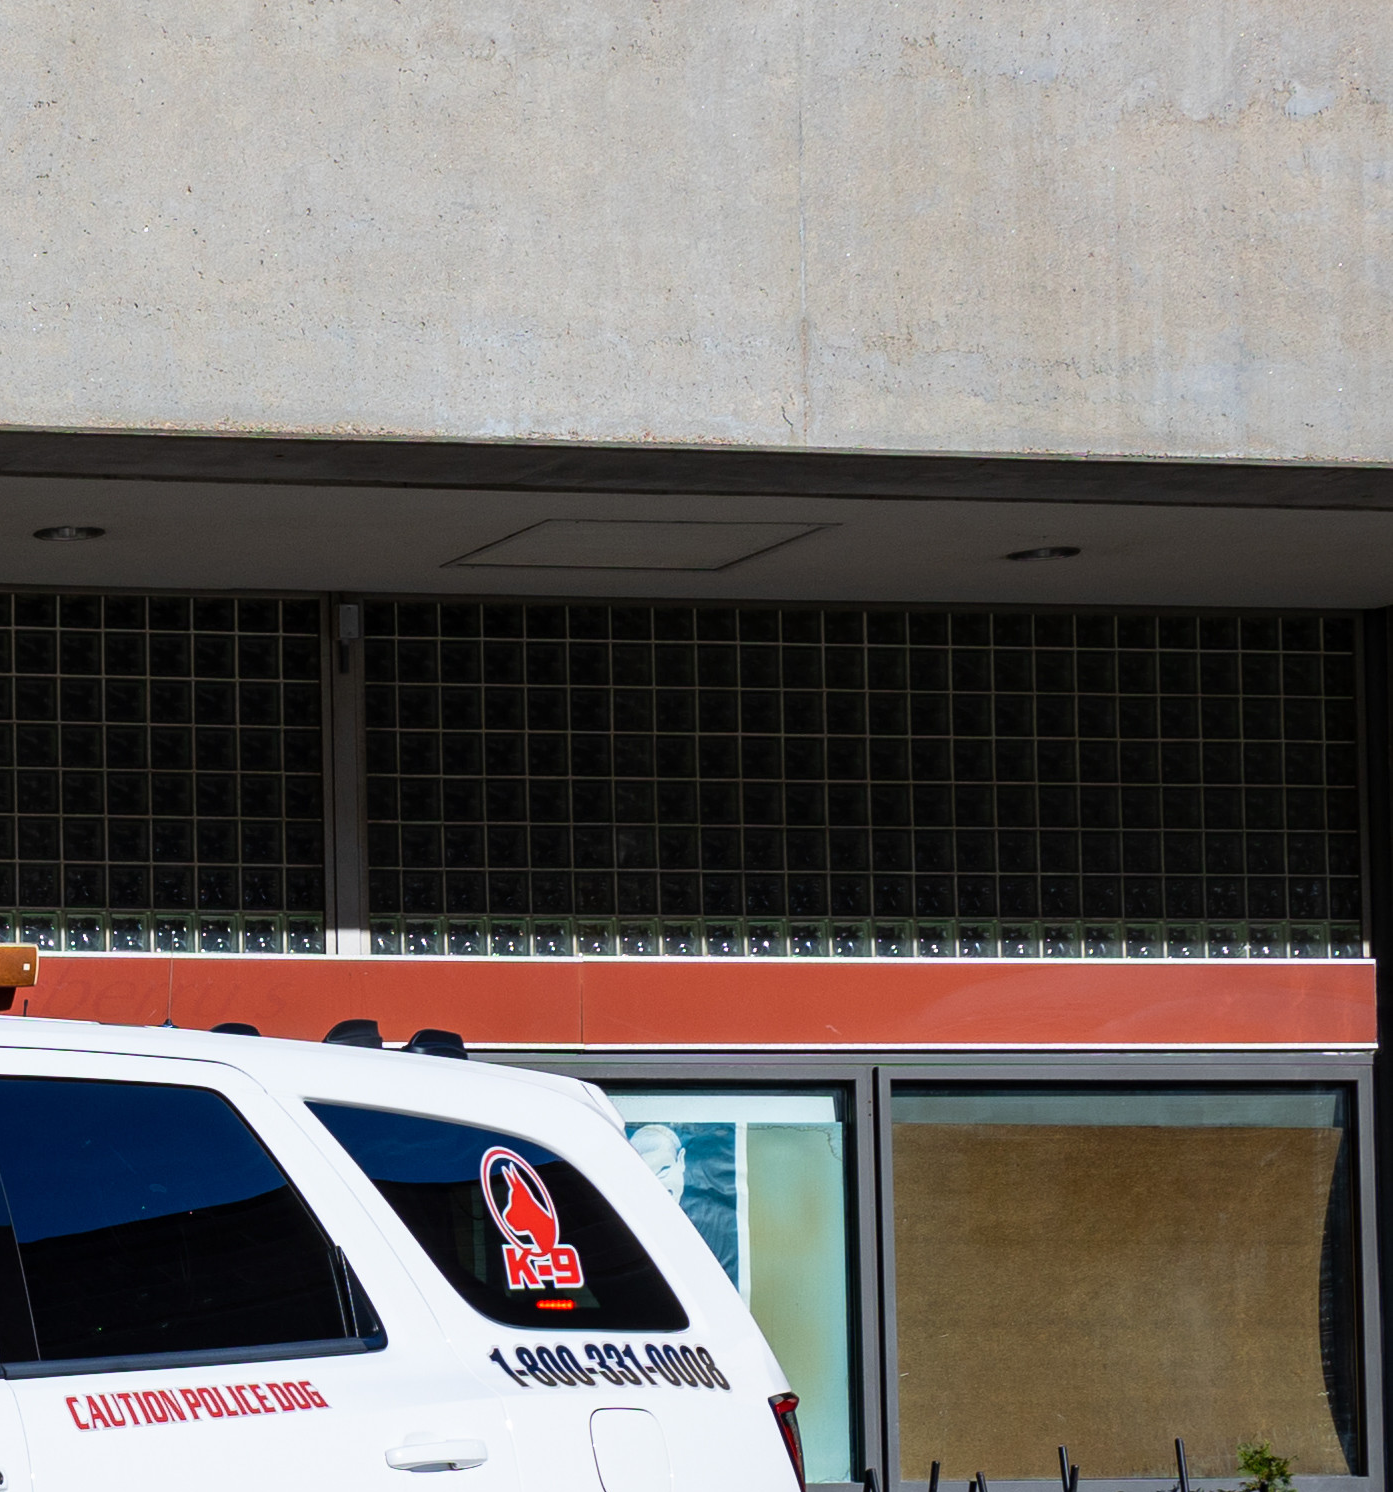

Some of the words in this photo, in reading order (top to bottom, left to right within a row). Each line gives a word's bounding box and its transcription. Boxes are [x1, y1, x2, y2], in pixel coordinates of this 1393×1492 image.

[502, 1244, 584, 1289] K-9
[489, 1344, 731, 1391] 1-800-331-0008
[66, 1390, 186, 1430] CAUTION
[179, 1384, 276, 1419] POLICE
[266, 1380, 329, 1411] DOG
